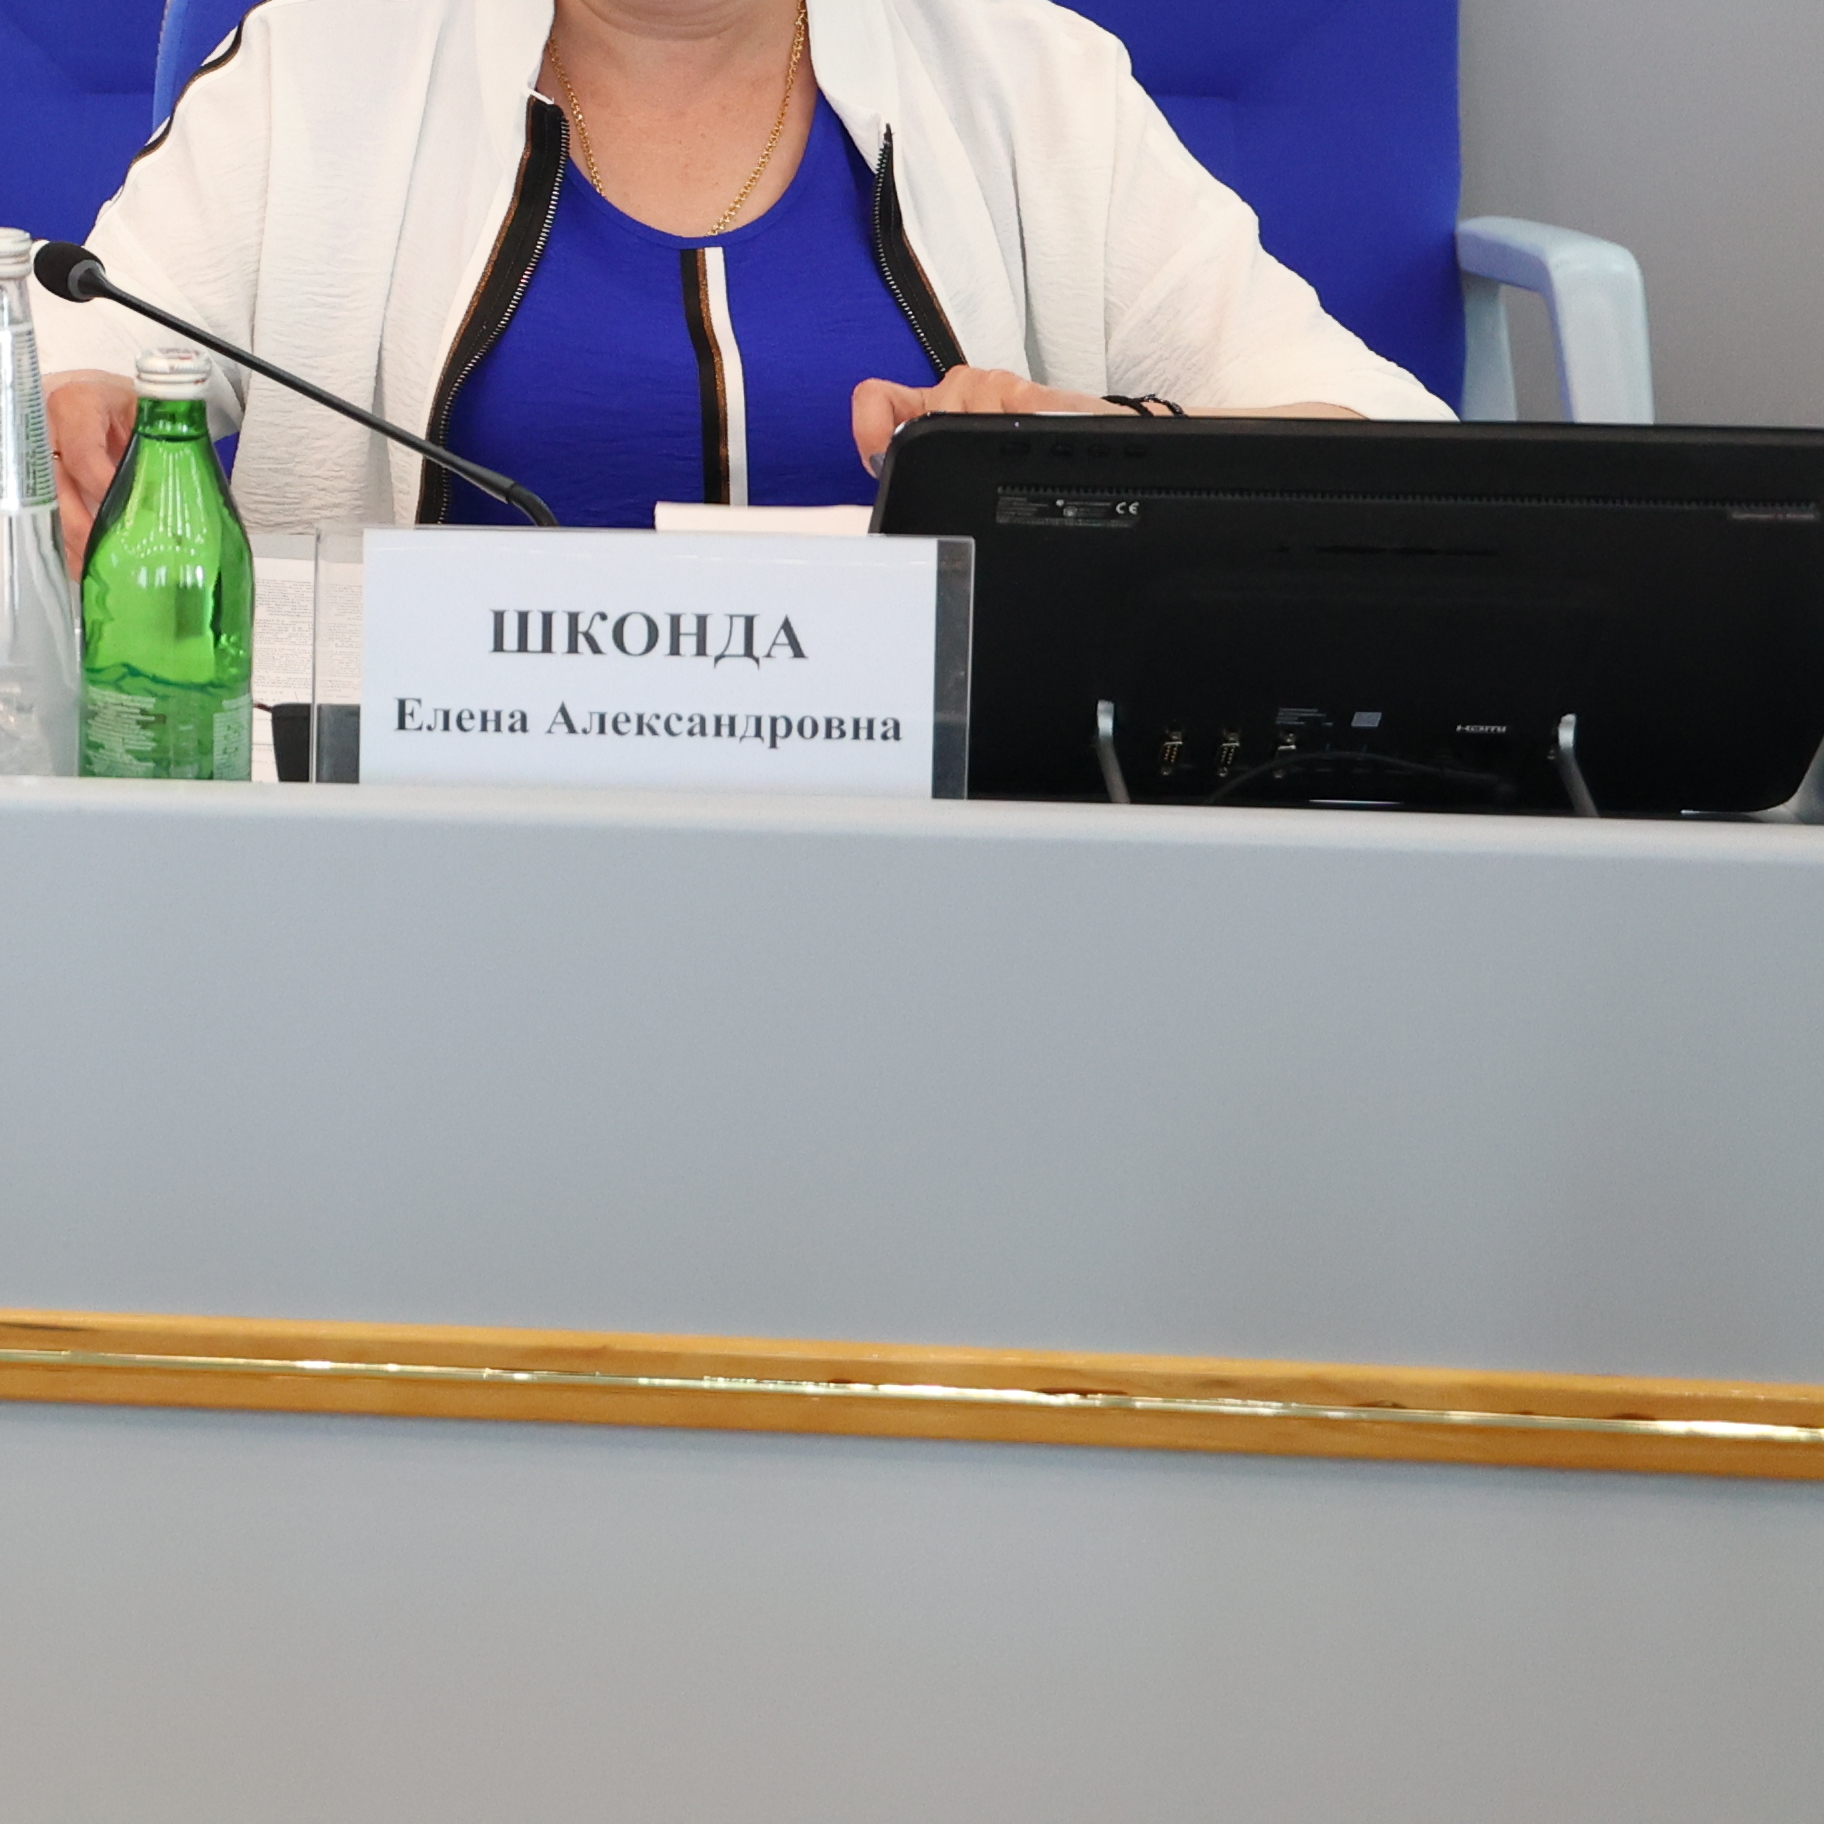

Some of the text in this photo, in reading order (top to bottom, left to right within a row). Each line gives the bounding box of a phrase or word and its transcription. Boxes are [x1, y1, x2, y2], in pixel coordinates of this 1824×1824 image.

[489, 608, 809, 669] ШКОНДА
[394, 696, 903, 750] Елена Александровна
